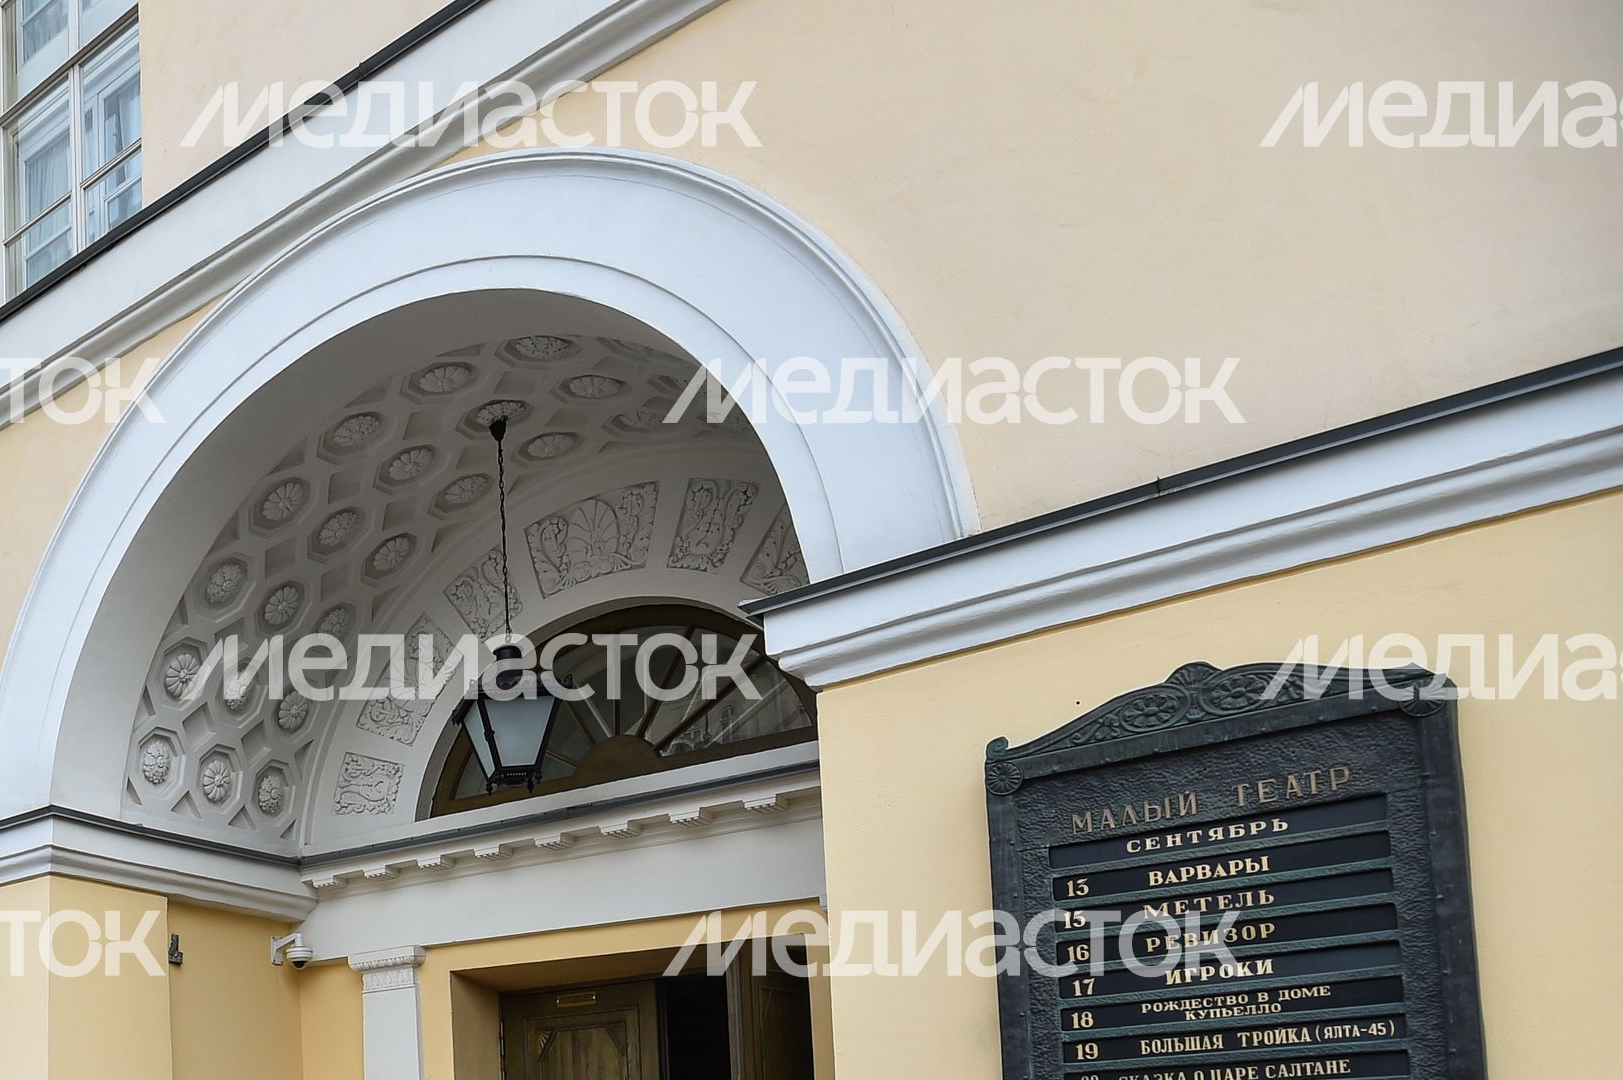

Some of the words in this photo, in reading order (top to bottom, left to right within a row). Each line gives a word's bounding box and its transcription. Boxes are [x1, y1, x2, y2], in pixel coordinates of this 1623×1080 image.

[1072, 790, 1198, 834] МАЛЫЙ
[1231, 766, 1351, 807] ТЕАТР
[1126, 818, 1289, 853] СЕНТЯБРЬ
[1067, 879, 1090, 897] 13
[1148, 855, 1271, 887] ВАРВАРЫ
[1063, 909, 1087, 929] 15
[1143, 890, 1275, 919] МЕТЕЛЬ
[1067, 944, 1090, 963] 16
[1146, 922, 1275, 953] РЕВИЗОР
[1072, 978, 1096, 996] 17
[1165, 959, 1275, 985] ИГРОКИ
[1071, 1011, 1094, 1029] 18
[1141, 993, 1249, 1014] РОЖДЕСТВО
[1257, 992, 1270, 1003] В
[1278, 985, 1332, 1002] ДОМЕ
[1185, 1002, 1282, 1021] КУПЬЕЛЛО
[1075, 1042, 1099, 1060] 19
[1140, 1034, 1225, 1055] БОЛЬШАЯ
[1237, 1026, 1312, 1048] ТРОЙКА
[1315, 1019, 1395, 1042] (ЯЛТА-45)
[1265, 1059, 1351, 1079] САЛТАНЕ
